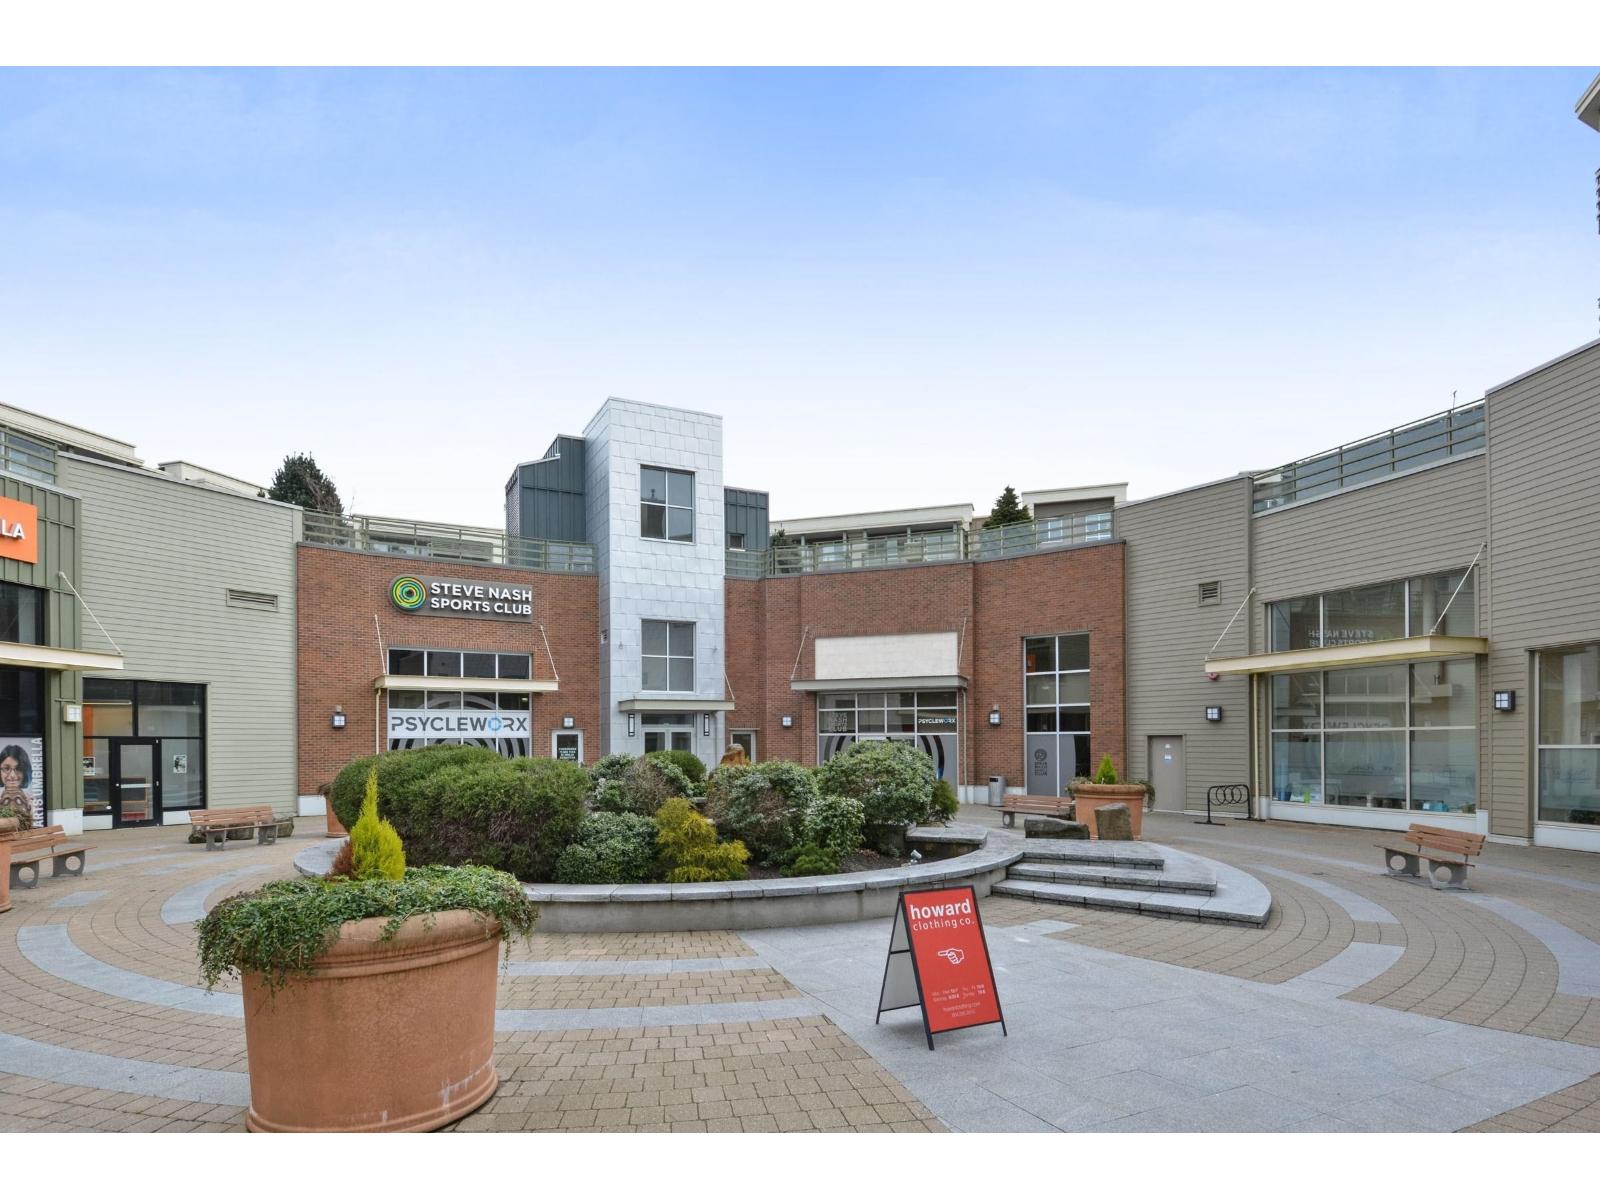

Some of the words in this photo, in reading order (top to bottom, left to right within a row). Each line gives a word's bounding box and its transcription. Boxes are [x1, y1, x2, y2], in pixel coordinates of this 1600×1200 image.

[0, 519, 25, 540] LA
[431, 582, 484, 598] STEVE
[488, 587, 532, 602] NASH
[431, 597, 491, 612] SPORTS
[494, 602, 532, 615] CLUB
[391, 716, 528, 732] PSYCLEWORX
[31, 737, 44, 795] UMBRELLA
[32, 798, 44, 828] ARTS
[910, 898, 971, 920] howard
[913, 918, 958, 931] clothing
[960, 917, 975, 926] co.
